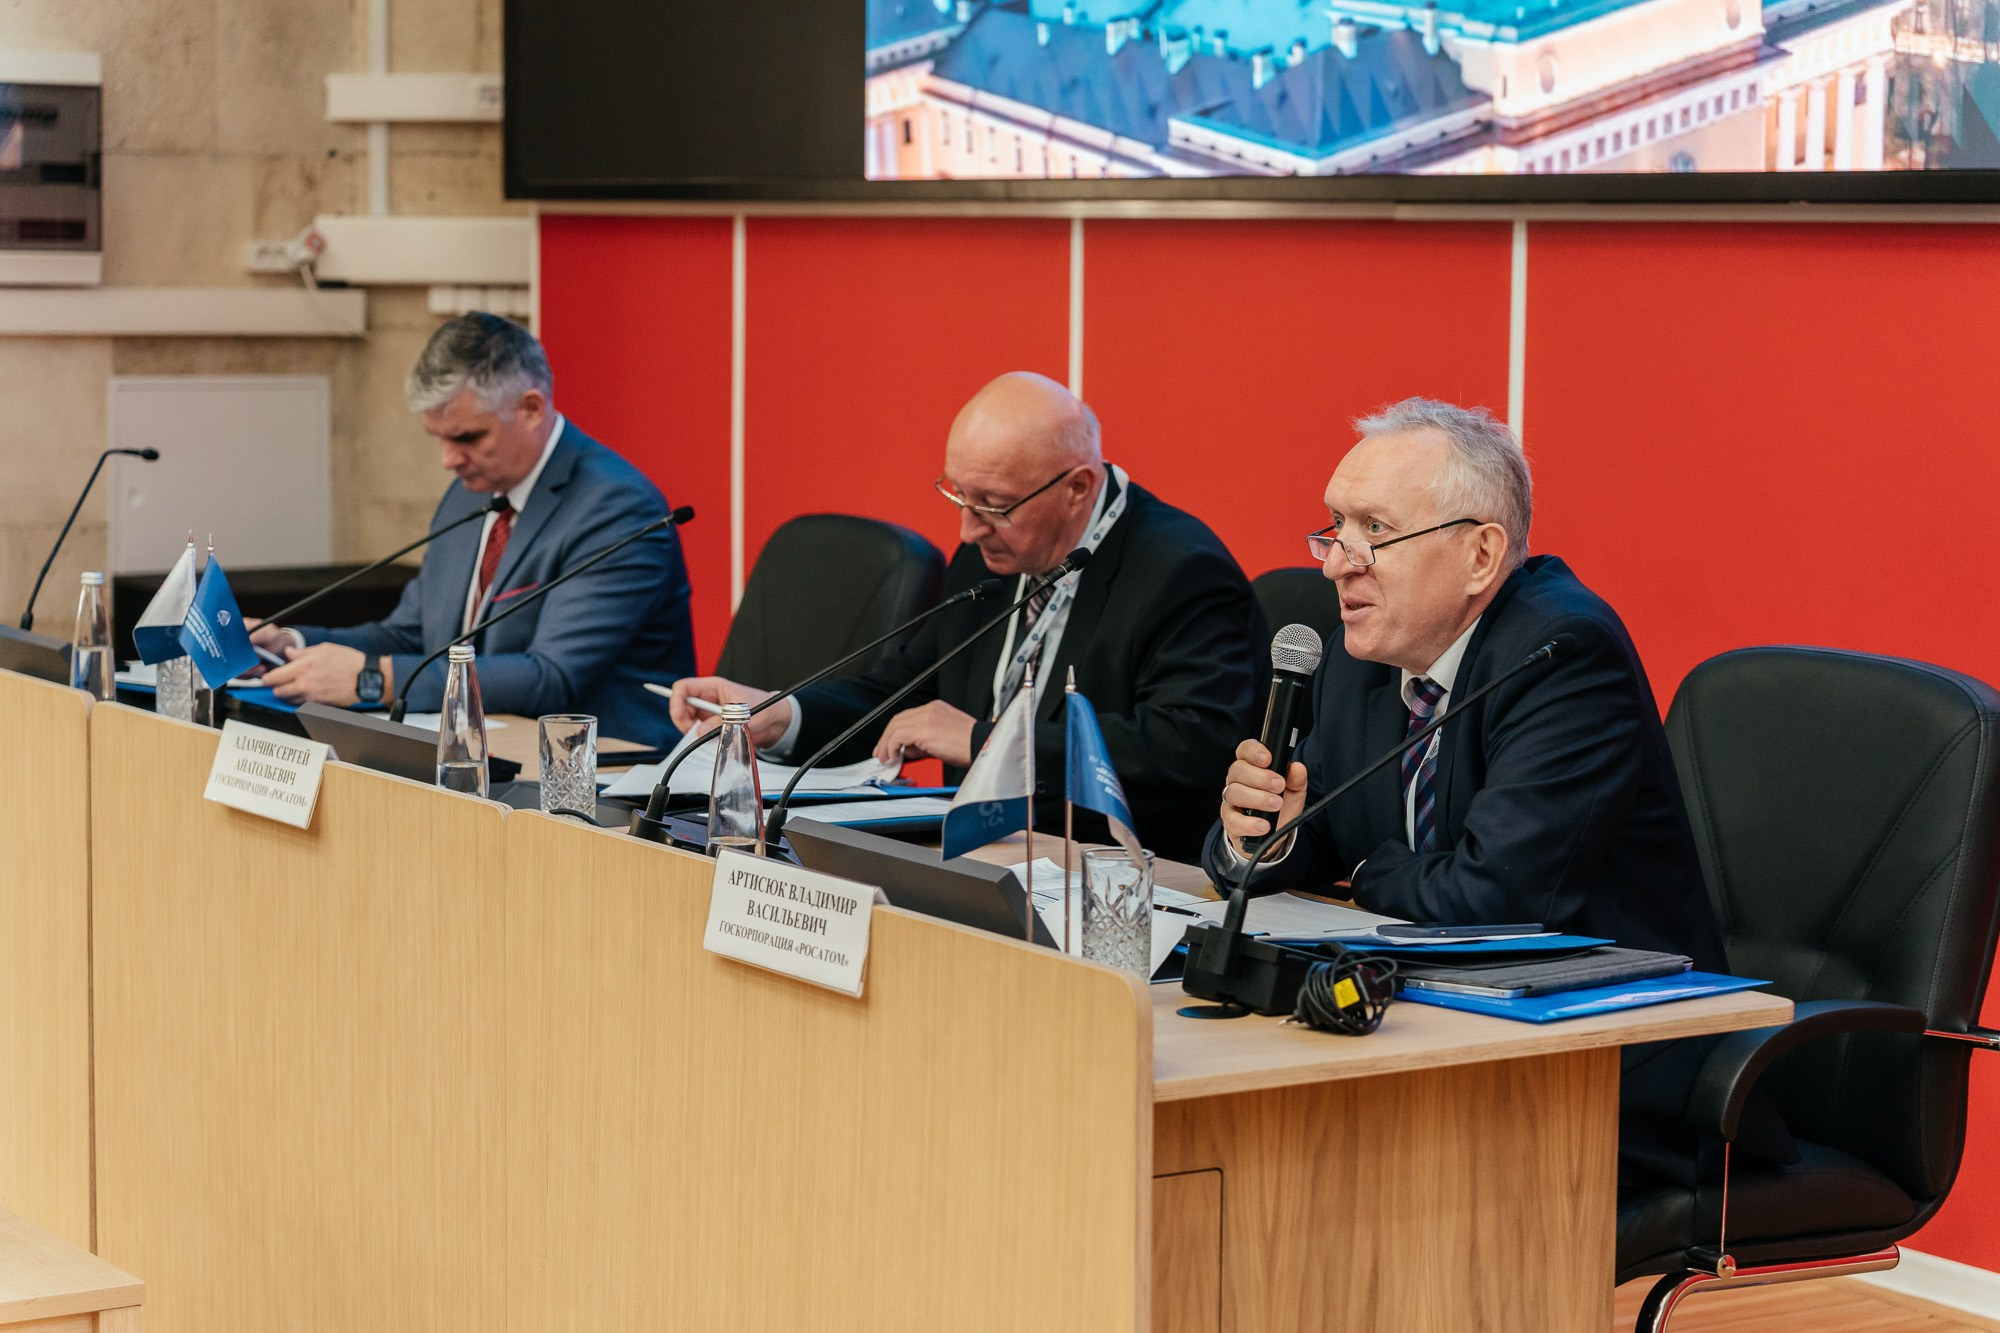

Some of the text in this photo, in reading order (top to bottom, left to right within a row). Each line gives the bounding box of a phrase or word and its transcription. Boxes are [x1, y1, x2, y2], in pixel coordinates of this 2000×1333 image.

[235, 735, 311, 766] АДАМЧИК СЕРГЕЙ
[234, 758, 297, 786] АНАТОЛЬЕВИЧ
[728, 869, 858, 916] АРТИСЮК ВЛАДИМИР
[746, 899, 828, 936] ВАСИЛЬЕВИЧ
[718, 920, 849, 967] ГОСКОРПОРАЦИЯ «РОСАТОМ»
